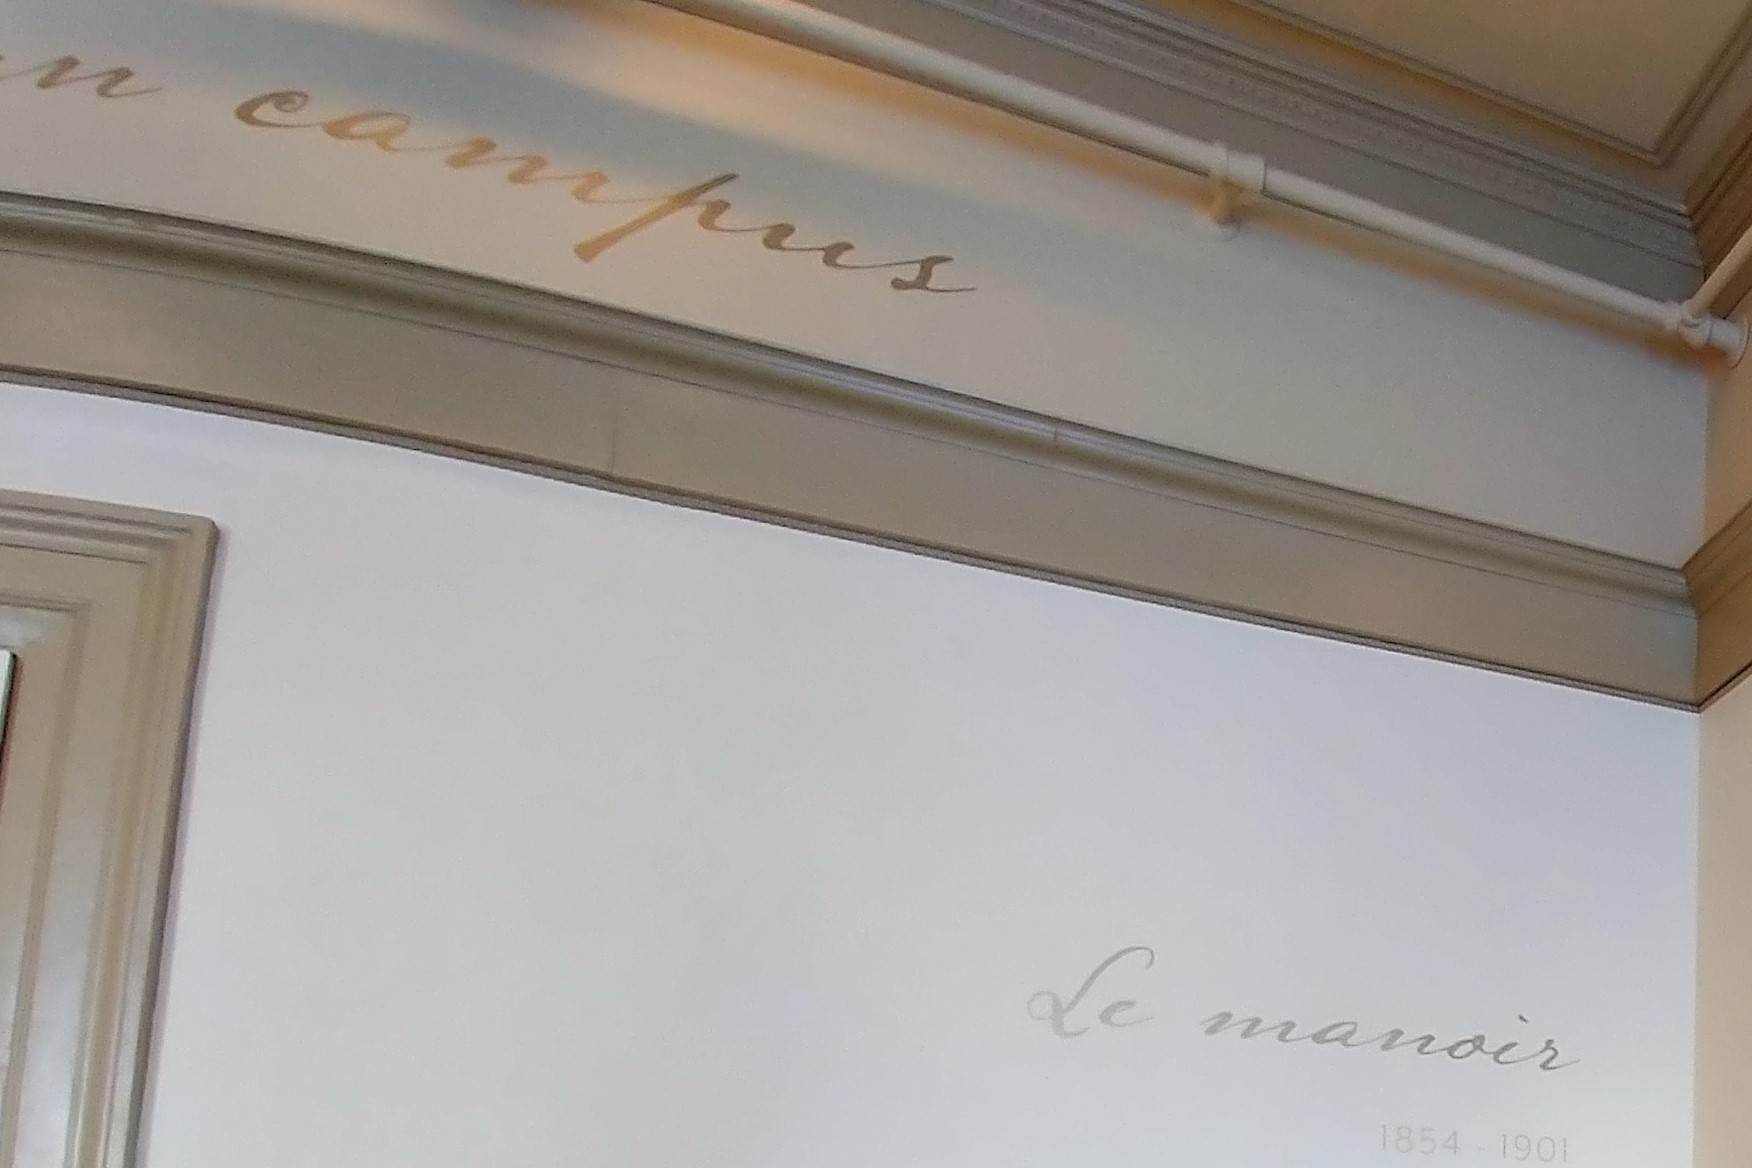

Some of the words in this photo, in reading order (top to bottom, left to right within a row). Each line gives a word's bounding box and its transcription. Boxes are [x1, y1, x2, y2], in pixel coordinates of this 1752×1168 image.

[234, 88, 977, 293] campus
[1027, 946, 1155, 1039] Le
[1202, 1010, 1580, 1071] manoir
[1381, 1124, 1461, 1155] 1854
[1502, 1133, 1568, 1163] 1901
